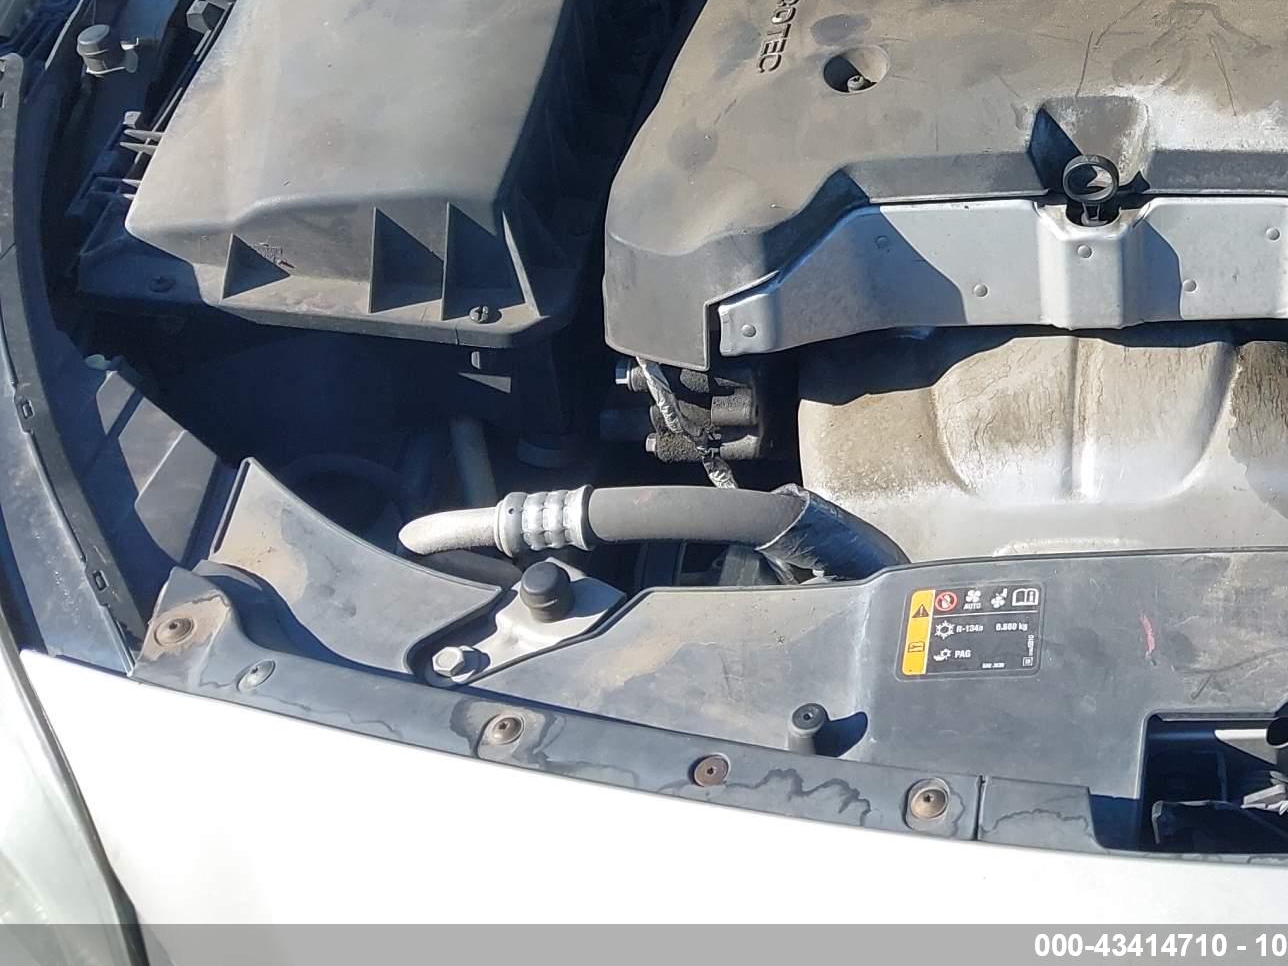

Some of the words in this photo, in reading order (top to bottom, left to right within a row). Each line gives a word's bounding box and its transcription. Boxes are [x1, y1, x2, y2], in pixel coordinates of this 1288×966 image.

[963, 602, 981, 610] AUTO
[1018, 622, 1028, 632] kg
[954, 649, 972, 659] PAG
